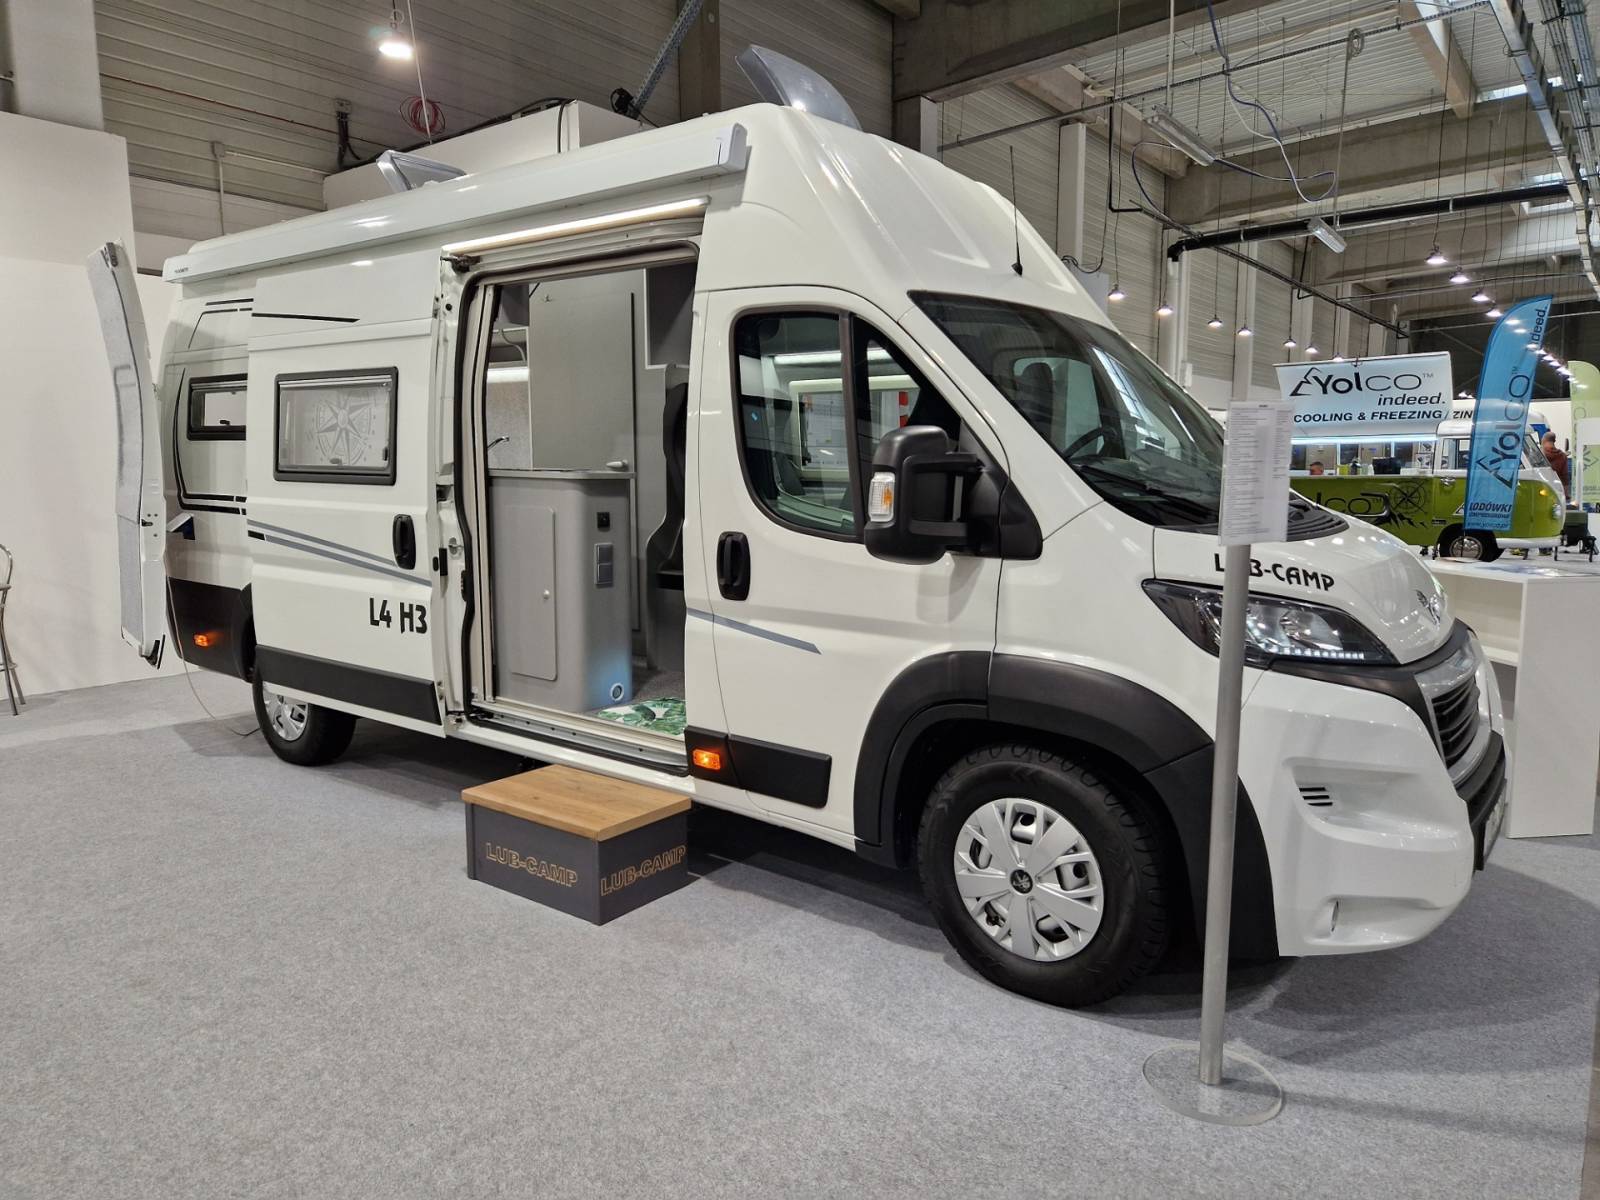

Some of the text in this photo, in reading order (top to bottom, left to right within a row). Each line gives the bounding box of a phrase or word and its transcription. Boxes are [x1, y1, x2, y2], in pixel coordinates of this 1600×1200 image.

[1293, 410, 1442, 423] COOLING & FREEZING
[1377, 392, 1446, 406] indeed.
[1214, 553, 1335, 591] LB-CAMP
[370, 598, 428, 634] L4 H3
[486, 842, 578, 888] LUB-CAMP
[600, 844, 686, 897] LUB-CAMP
